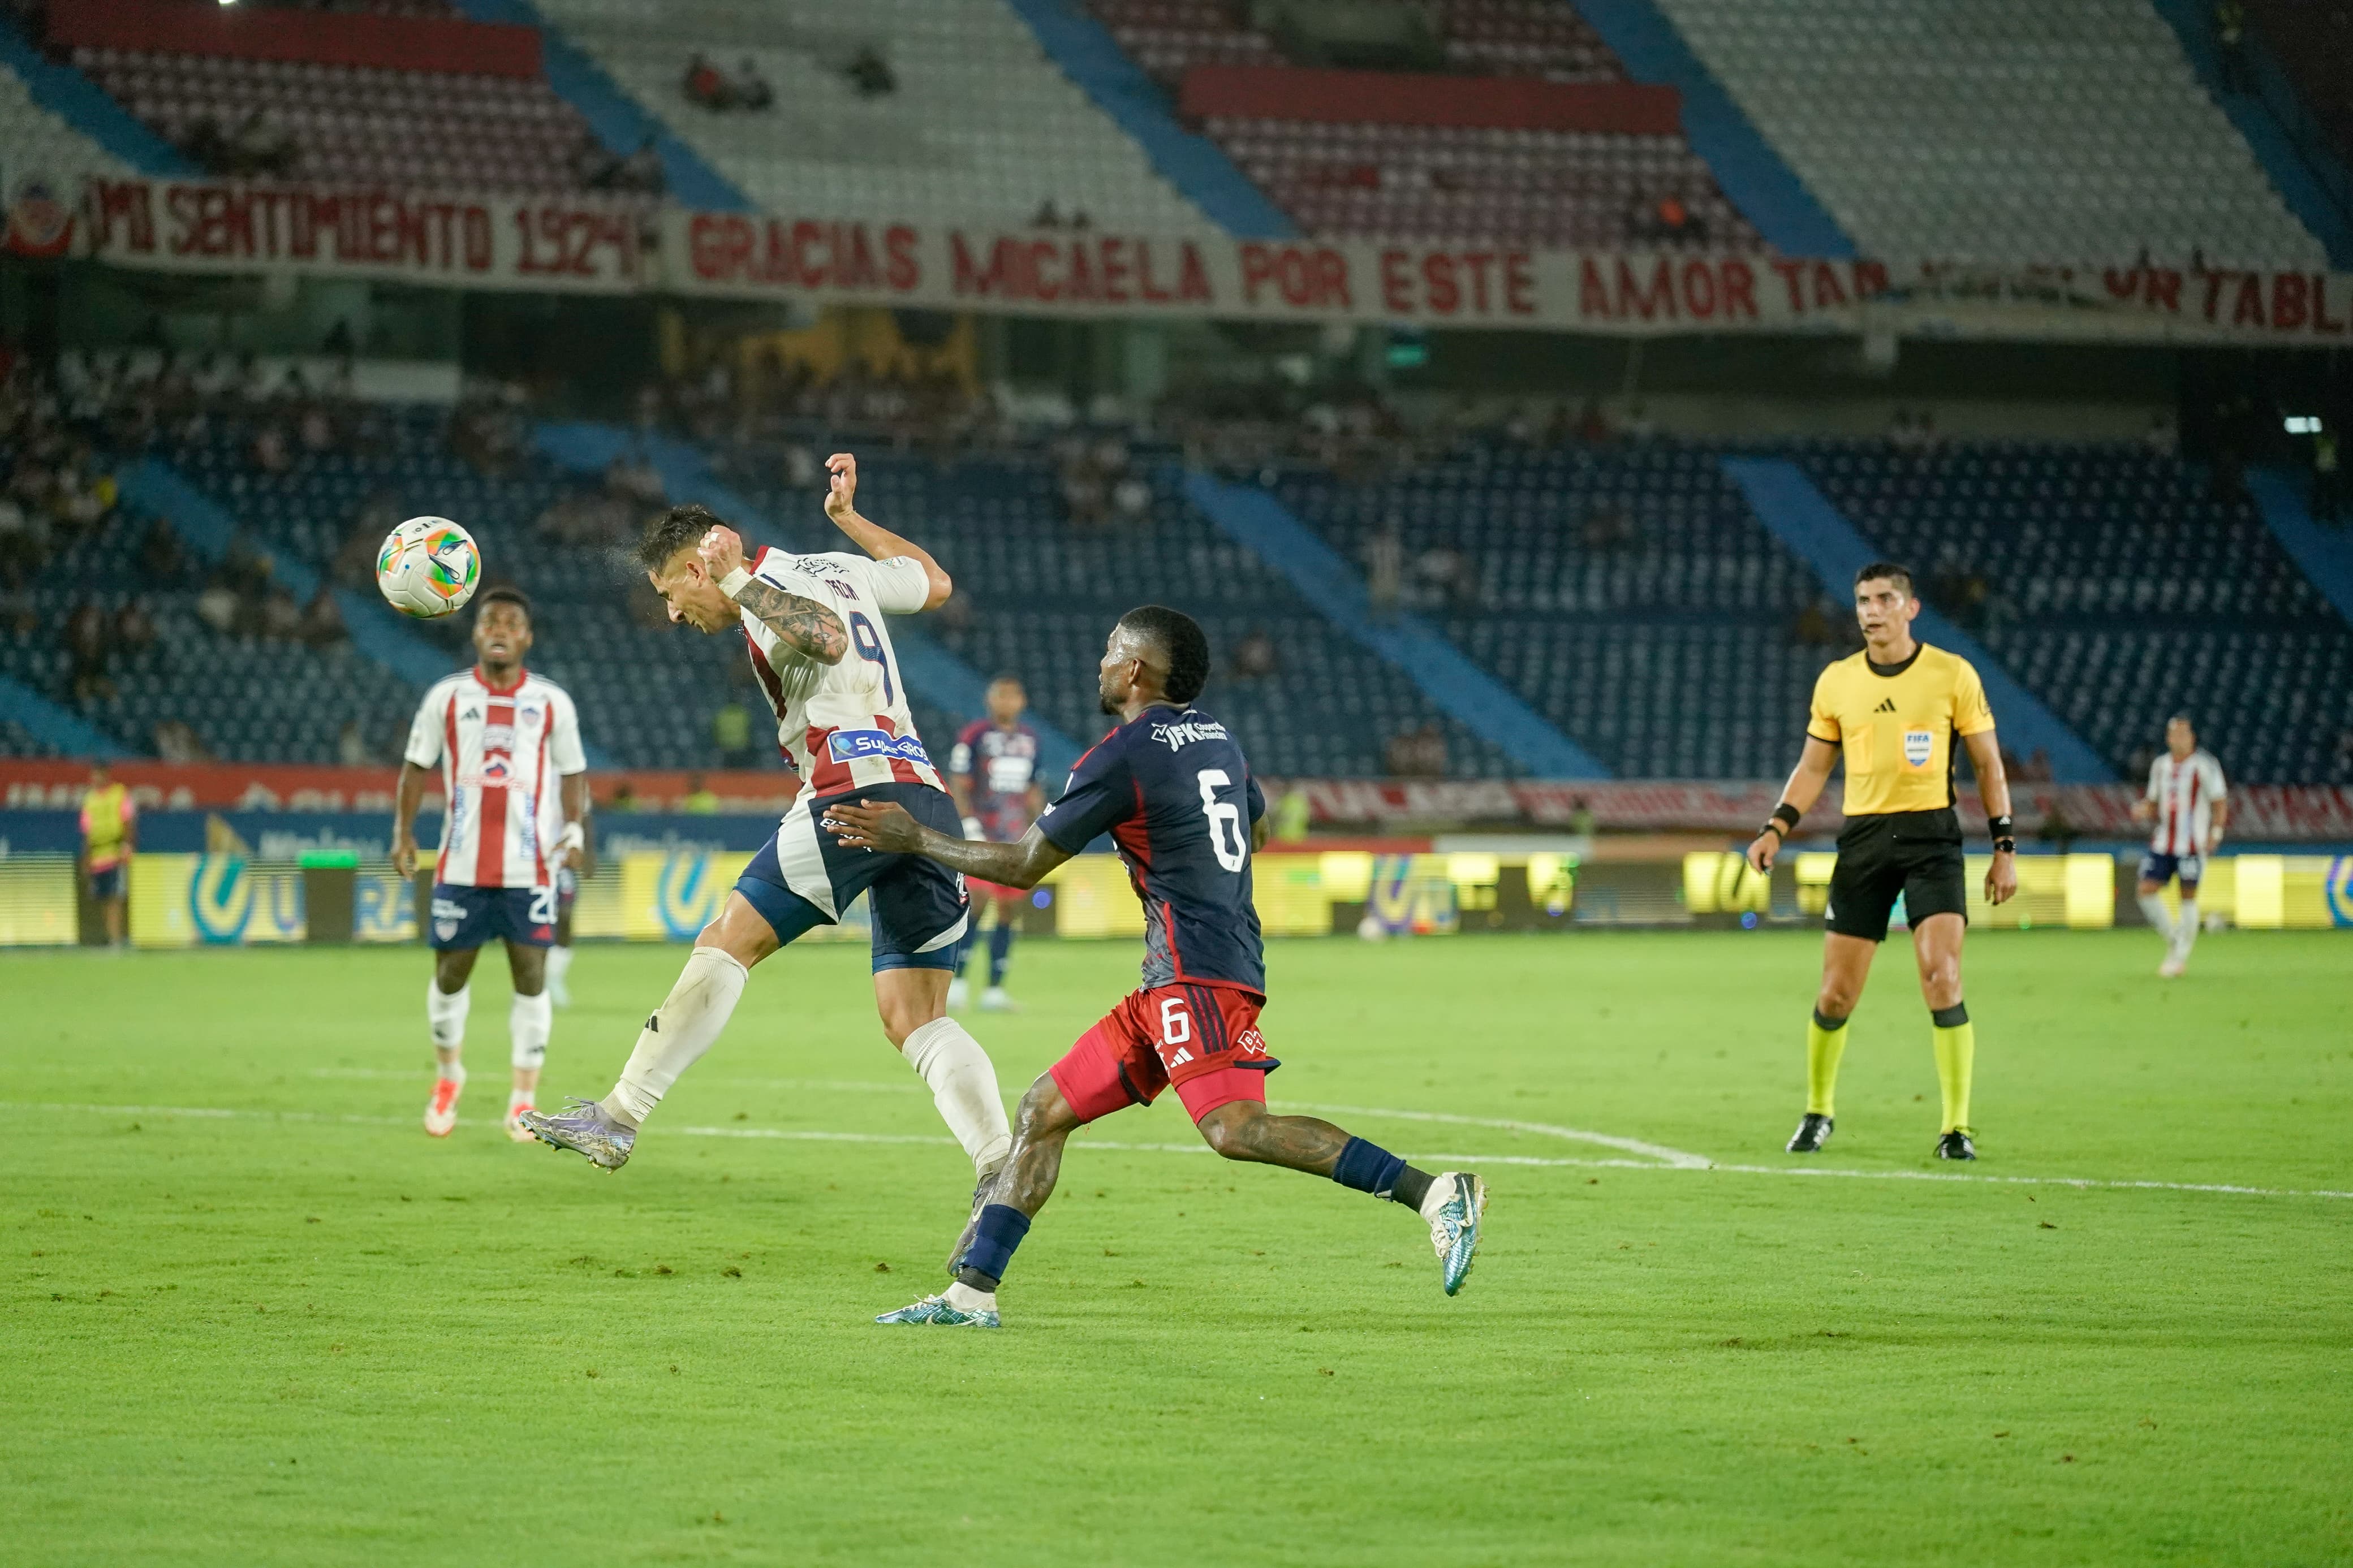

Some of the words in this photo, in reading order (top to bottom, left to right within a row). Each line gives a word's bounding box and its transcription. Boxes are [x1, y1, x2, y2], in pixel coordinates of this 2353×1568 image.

[167, 185, 492, 271] SENTIMIENTO
[516, 208, 635, 279] 1924
[689, 214, 920, 290] GRACIAS
[947, 228, 1213, 303] MICAELA
[1239, 244, 1352, 308] POR
[1378, 249, 1537, 314] ESTE
[1578, 256, 1759, 320] AMOR
[850, 611, 894, 708] 9
[1165, 723, 1205, 753] JFK
[1197, 768, 1247, 873] 6
[1161, 997, 1191, 1045] 6
